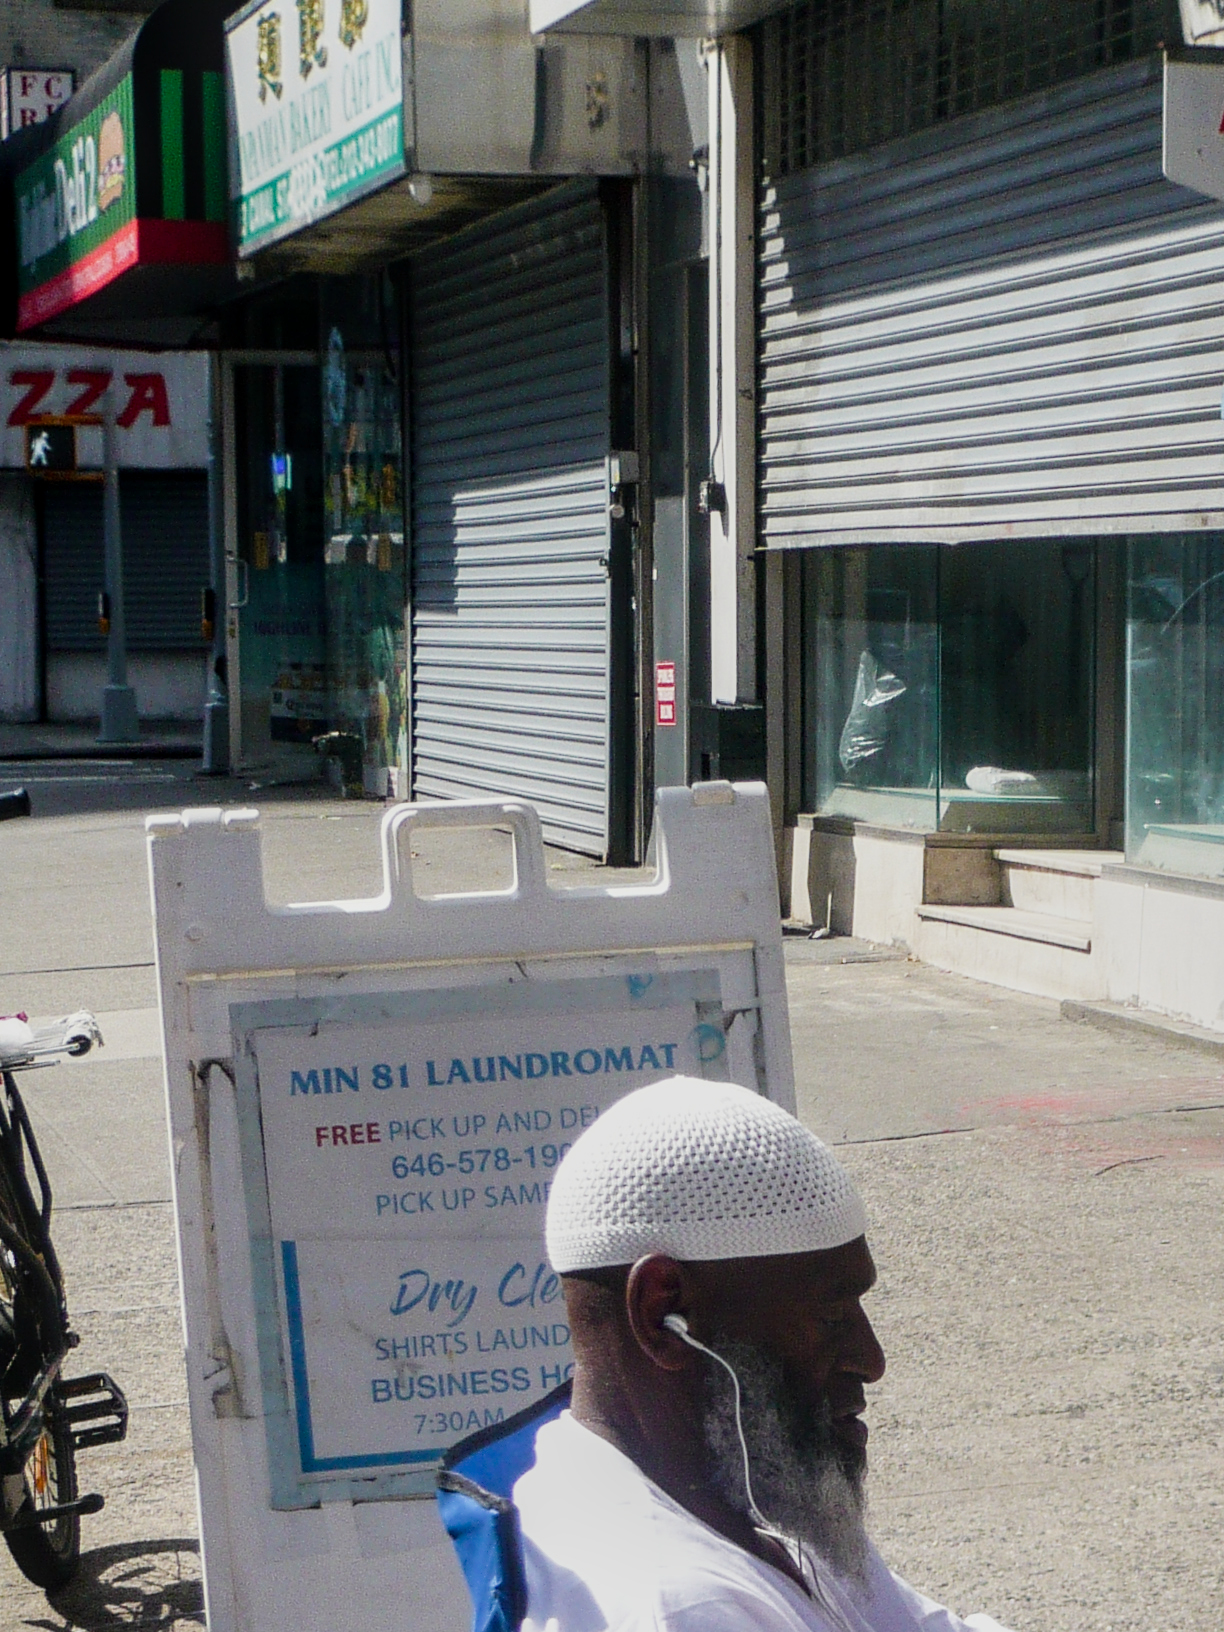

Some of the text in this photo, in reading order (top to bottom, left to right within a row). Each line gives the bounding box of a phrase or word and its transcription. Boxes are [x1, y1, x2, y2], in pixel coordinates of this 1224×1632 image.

[290, 1043, 678, 1096] MIN 81 LAUNDROMAT
[316, 1122, 381, 1148] FREE
[389, 1117, 446, 1143] PICK
[453, 1114, 486, 1138] UP
[496, 1110, 551, 1134] AND
[376, 1191, 434, 1216] PICK
[442, 1188, 476, 1211] UP
[390, 1262, 564, 1328] Dry Cle
[375, 1332, 468, 1361] SHIRTS
[371, 1366, 531, 1403] BUSINESS
[414, 1407, 505, 1435] 7:30AM
